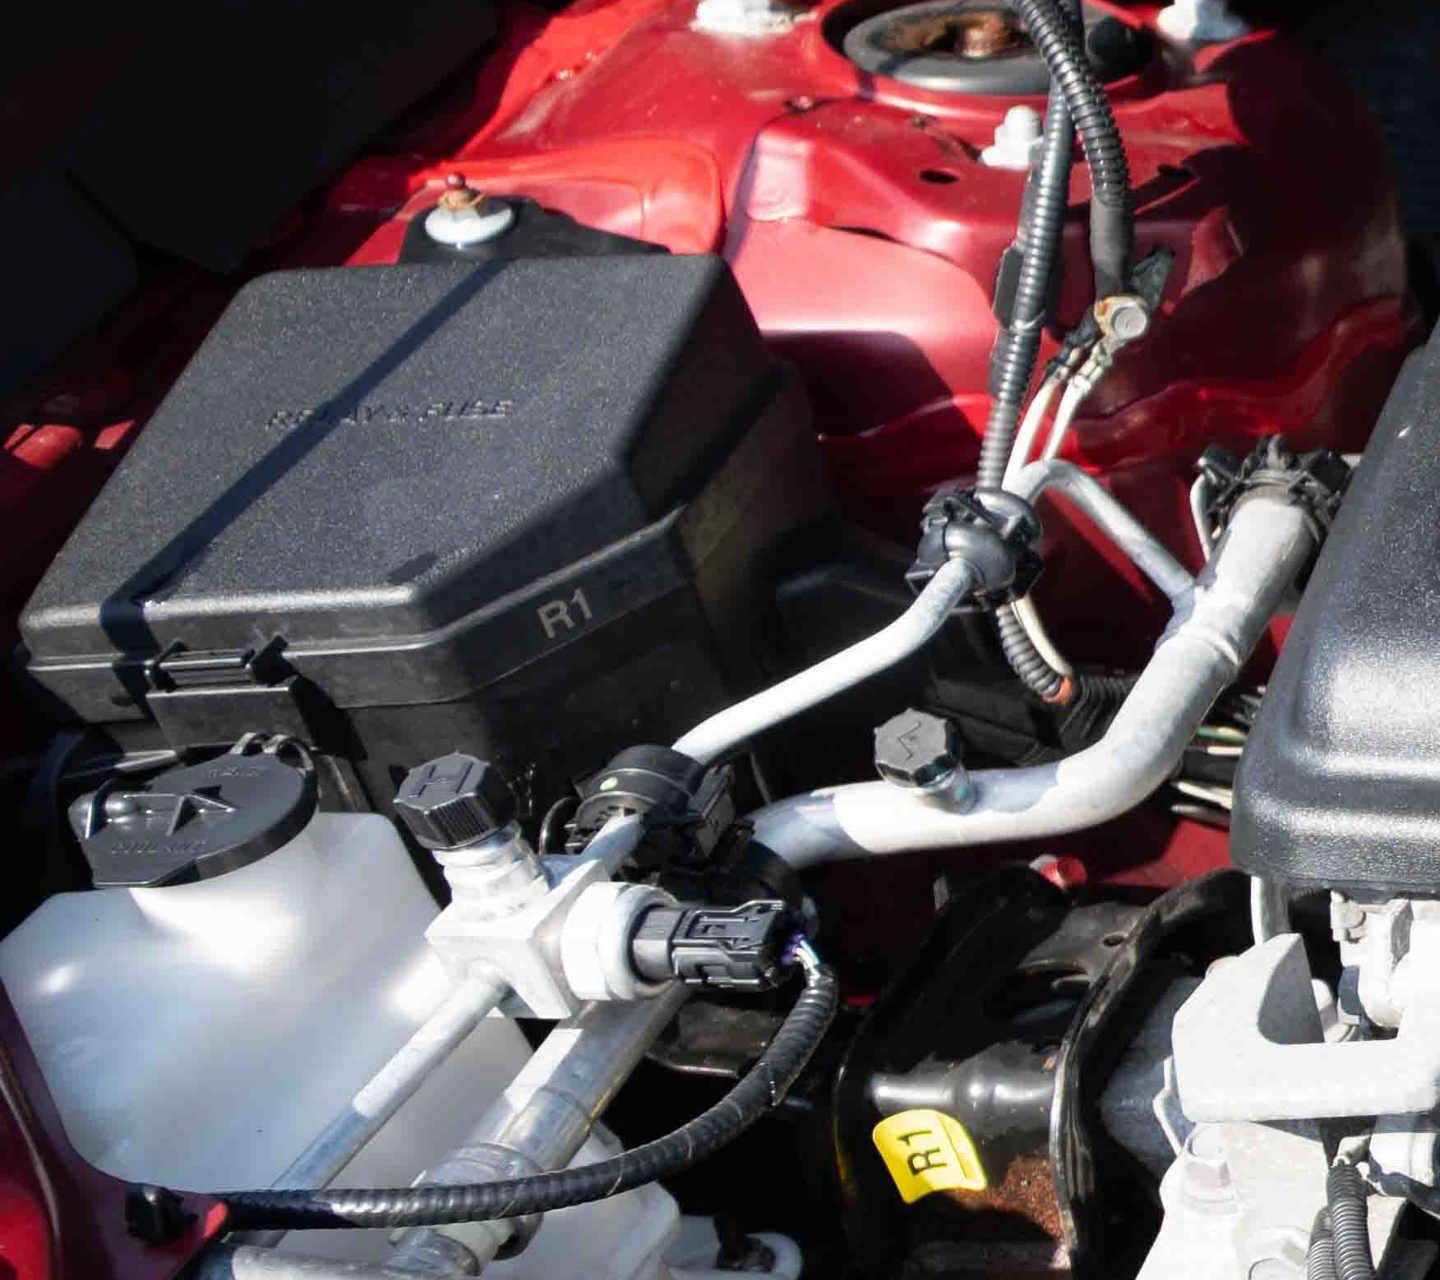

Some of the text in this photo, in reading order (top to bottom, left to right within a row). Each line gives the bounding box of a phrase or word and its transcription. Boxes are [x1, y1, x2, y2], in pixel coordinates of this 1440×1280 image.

[537, 588, 593, 638] R1
[407, 761, 475, 798] H
[897, 1129, 948, 1177] R1
